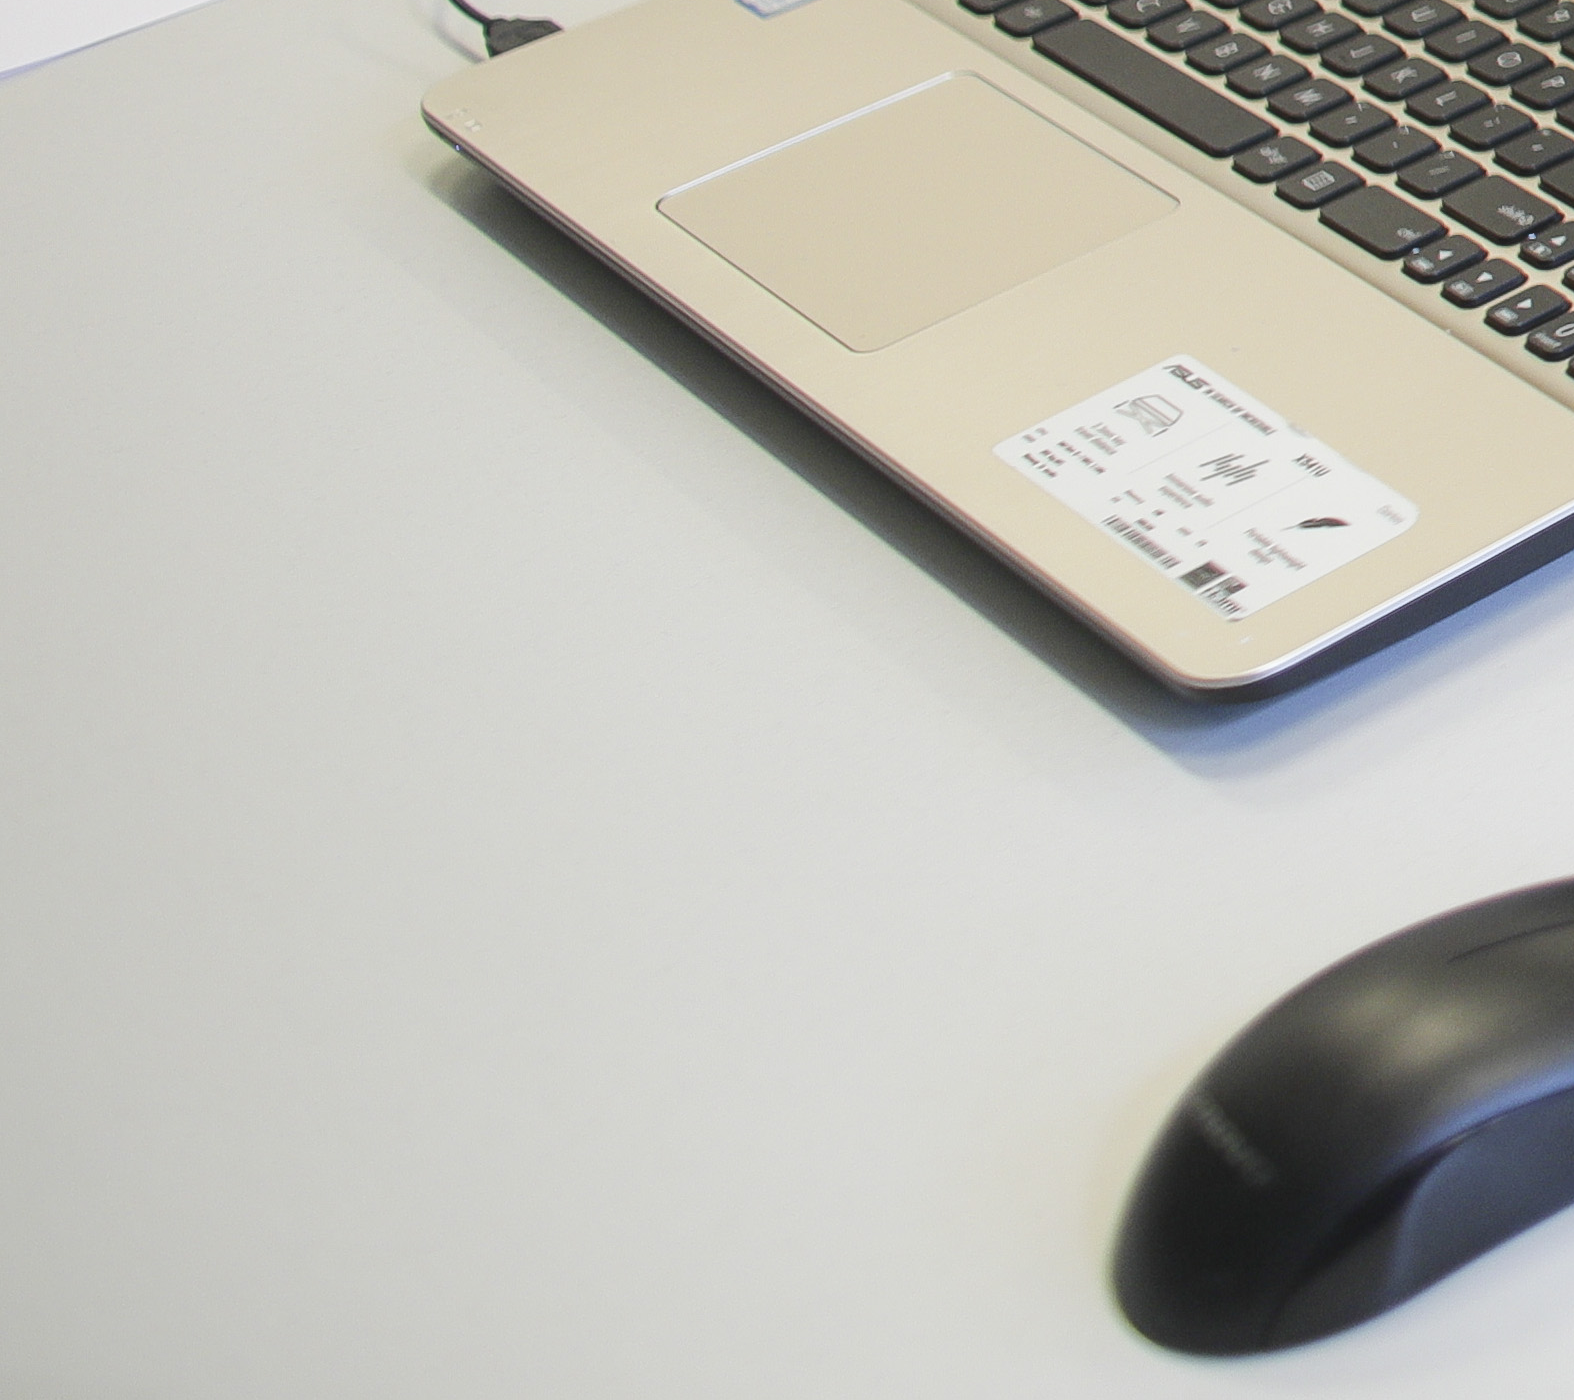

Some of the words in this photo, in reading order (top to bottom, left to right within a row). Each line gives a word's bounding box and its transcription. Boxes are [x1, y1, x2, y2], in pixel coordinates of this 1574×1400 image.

[1214, 42, 1238, 57] B
[1496, 51, 1521, 67] O
[1253, 63, 1280, 80] N
[1390, 66, 1417, 83] K
[1541, 75, 1565, 88] P
[1293, 88, 1322, 105] M
[1435, 90, 1456, 106] L
[1162, 364, 1210, 390] ASUS
